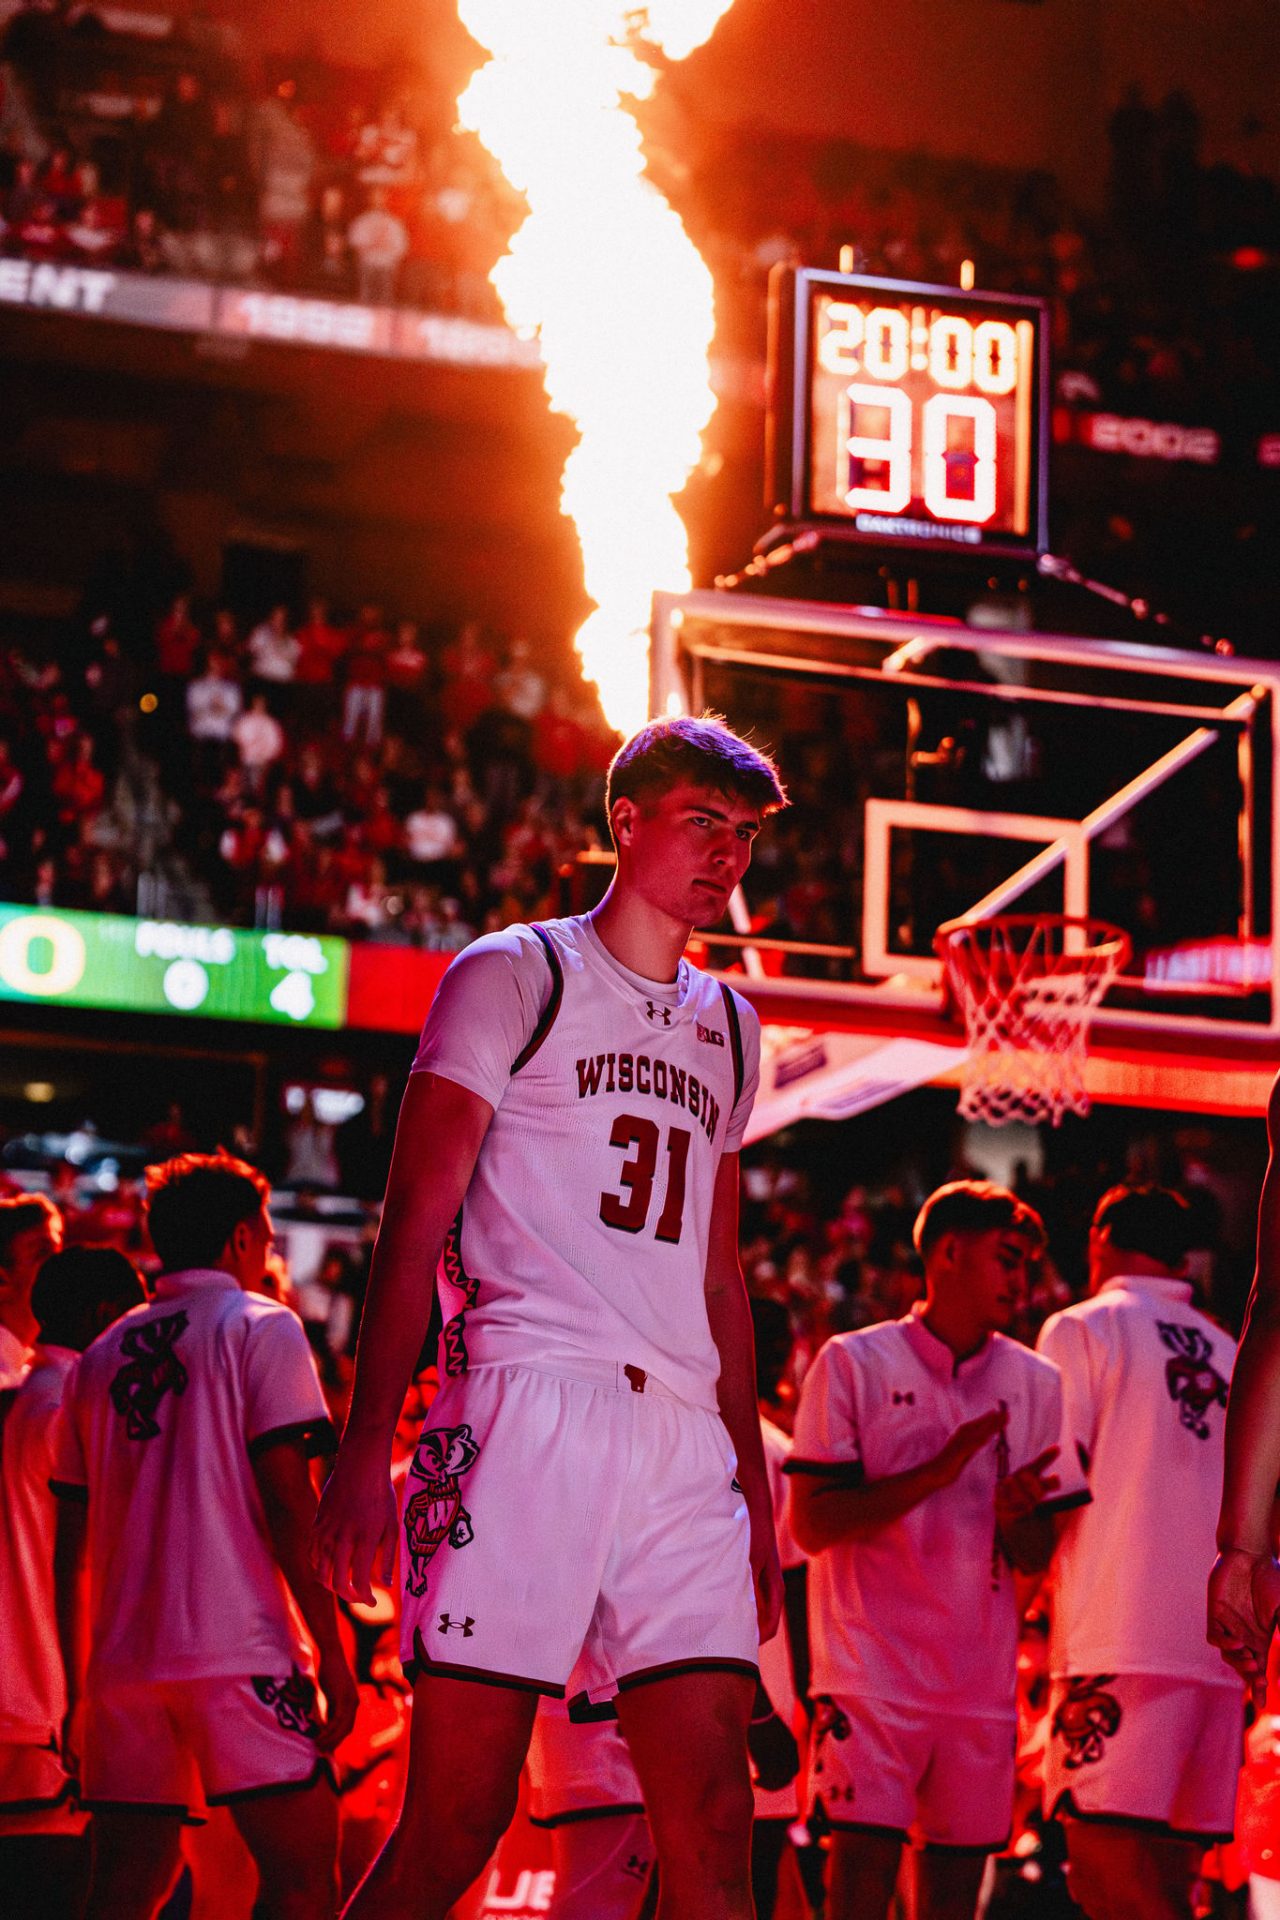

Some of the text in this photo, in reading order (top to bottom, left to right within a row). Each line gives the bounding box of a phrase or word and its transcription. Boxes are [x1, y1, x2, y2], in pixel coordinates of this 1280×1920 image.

[818, 302, 1018, 395] 20:00
[844, 383, 997, 523] 30
[576, 1053, 720, 1146] WISCONSIN
[599, 1113, 691, 1245] 31
